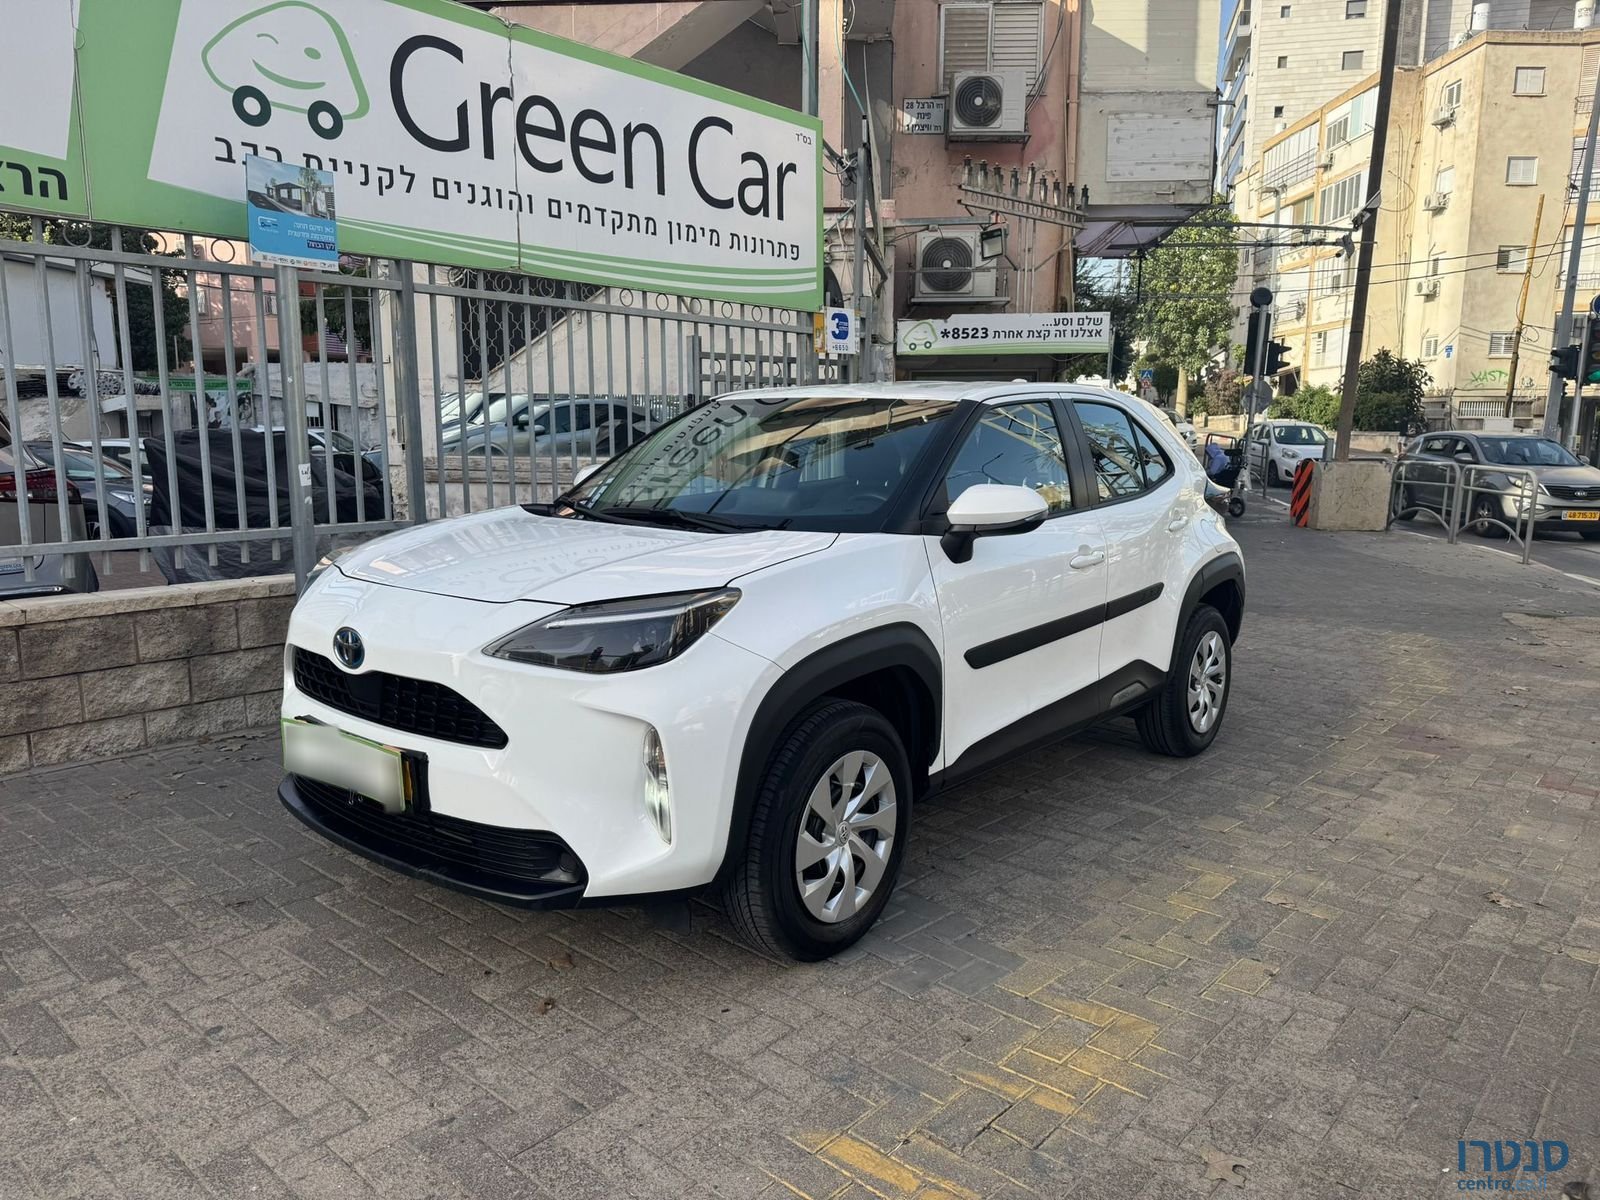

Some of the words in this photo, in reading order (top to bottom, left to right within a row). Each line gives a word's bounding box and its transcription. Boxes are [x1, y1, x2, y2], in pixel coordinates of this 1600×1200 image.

[905, 101, 914, 110] 28
[916, 100, 935, 110] הרצל
[916, 112, 932, 120] פינת
[390, 34, 666, 196] Green
[688, 115, 797, 221] Car
[0, 160, 68, 201] הר
[432, 176, 534, 214] והוגנים
[547, 197, 657, 236] מתקדמים
[667, 219, 721, 249] מימון
[730, 231, 800, 261] פתרונות
[1042, 317, 1073, 327] וסע...
[1077, 316, 1103, 326] שלם
[992, 329, 1024, 339] אחרת
[1027, 329, 1051, 341] קצת
[1055, 328, 1068, 338] זה
[1070, 327, 1102, 338] אצלנו
